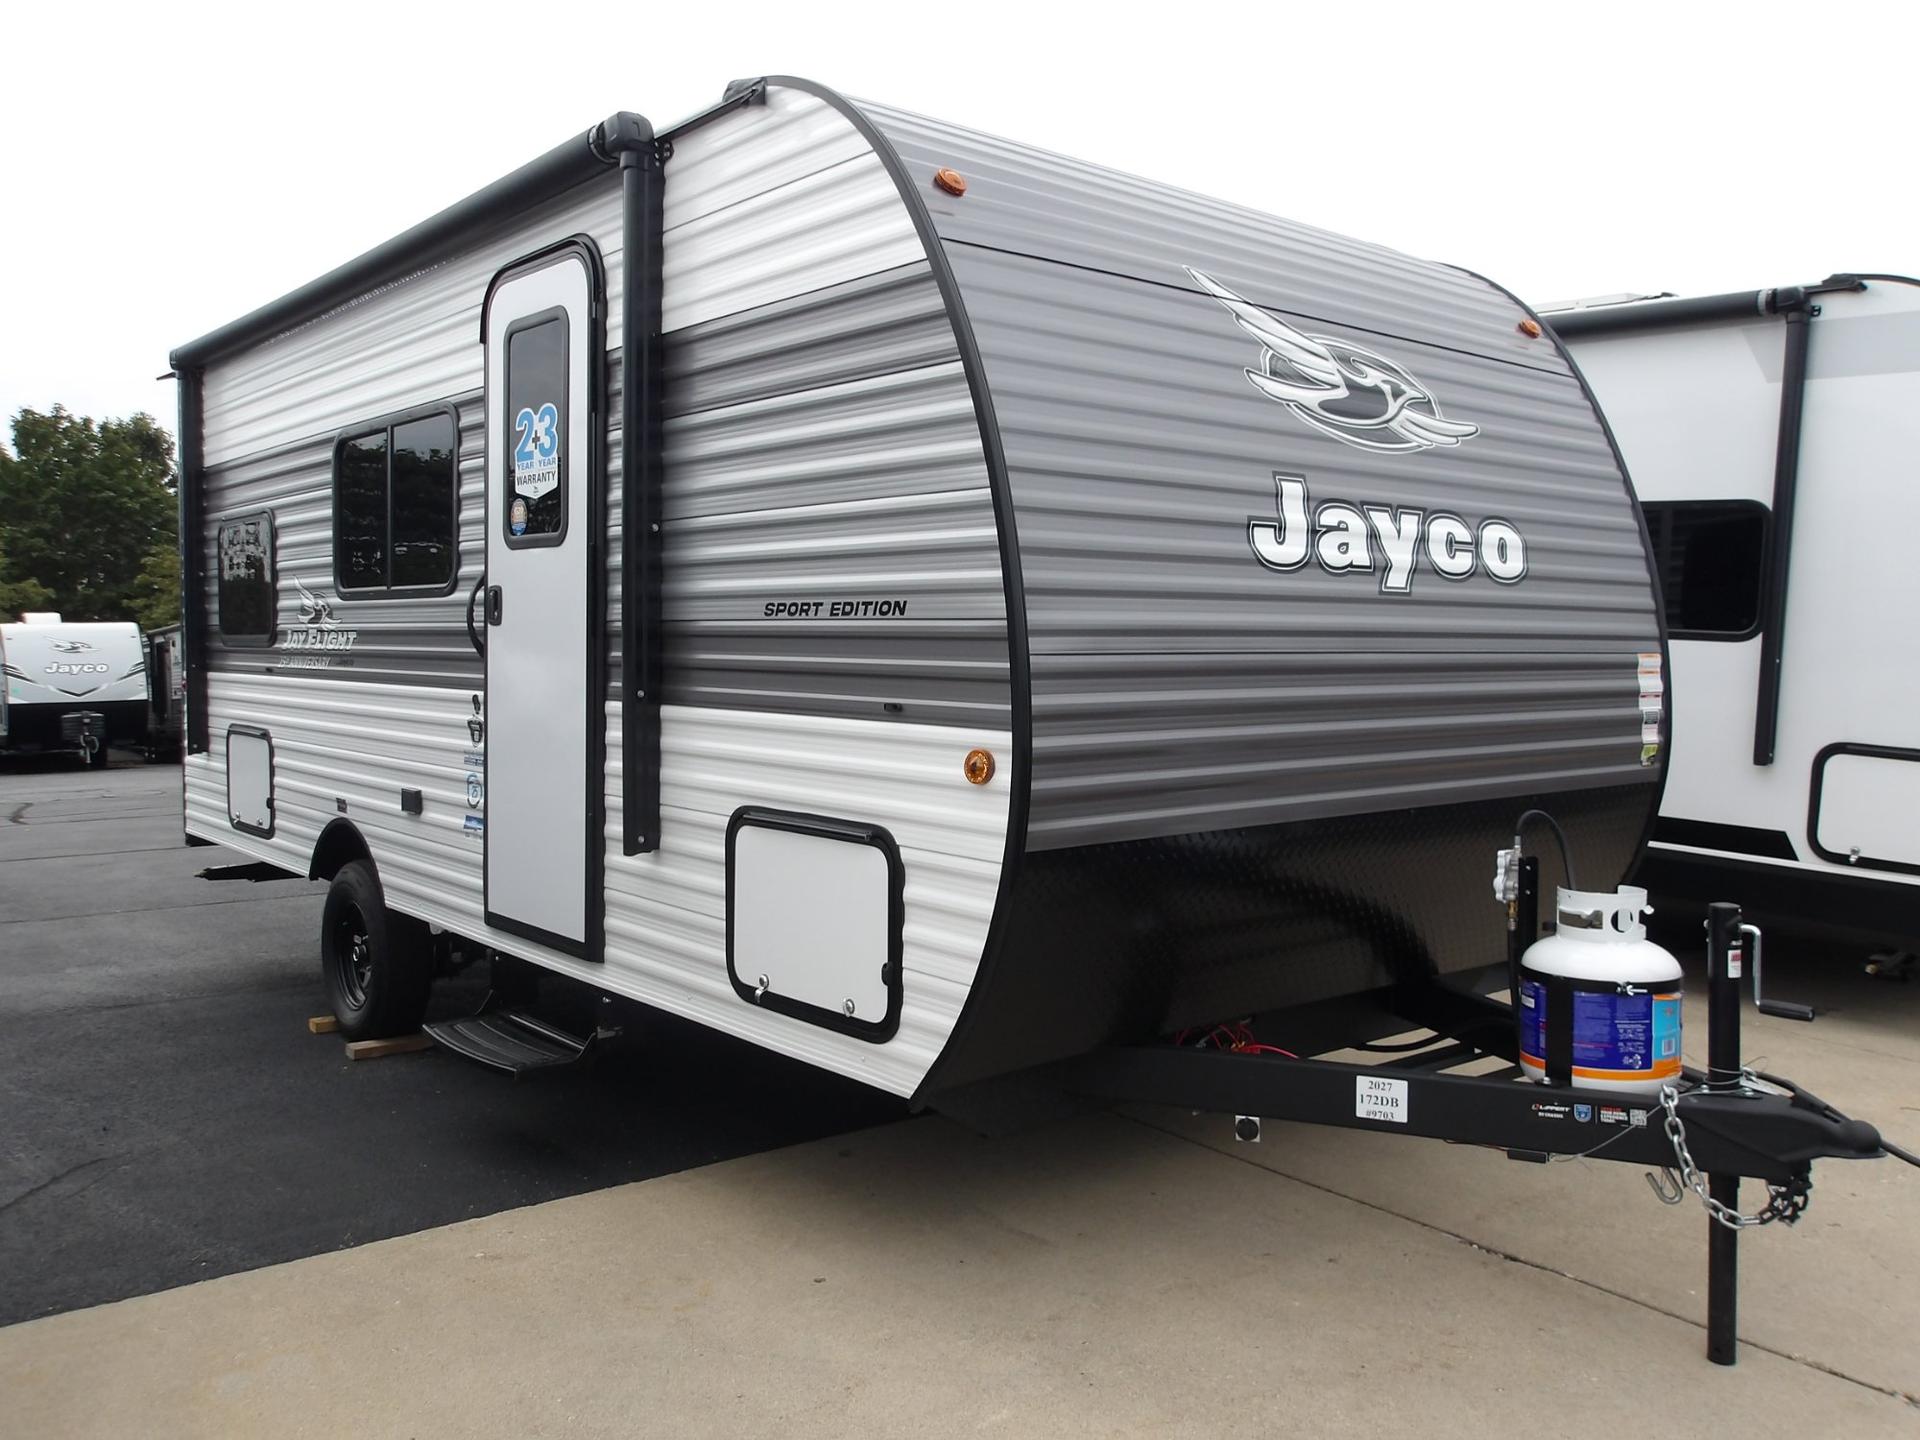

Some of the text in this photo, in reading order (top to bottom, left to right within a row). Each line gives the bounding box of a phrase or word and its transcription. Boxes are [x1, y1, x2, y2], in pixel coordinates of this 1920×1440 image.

[516, 456, 556, 472] YEAR YEAR
[516, 471, 557, 487] WARRANTY
[1249, 472, 1527, 595] Jayco
[764, 600, 908, 617] SPORT EDITION
[282, 628, 357, 651] JAY FLIGHT
[45, 661, 109, 675] Jayco
[1368, 1080, 1393, 1091] 2027
[1360, 1093, 1399, 1108] 172DB
